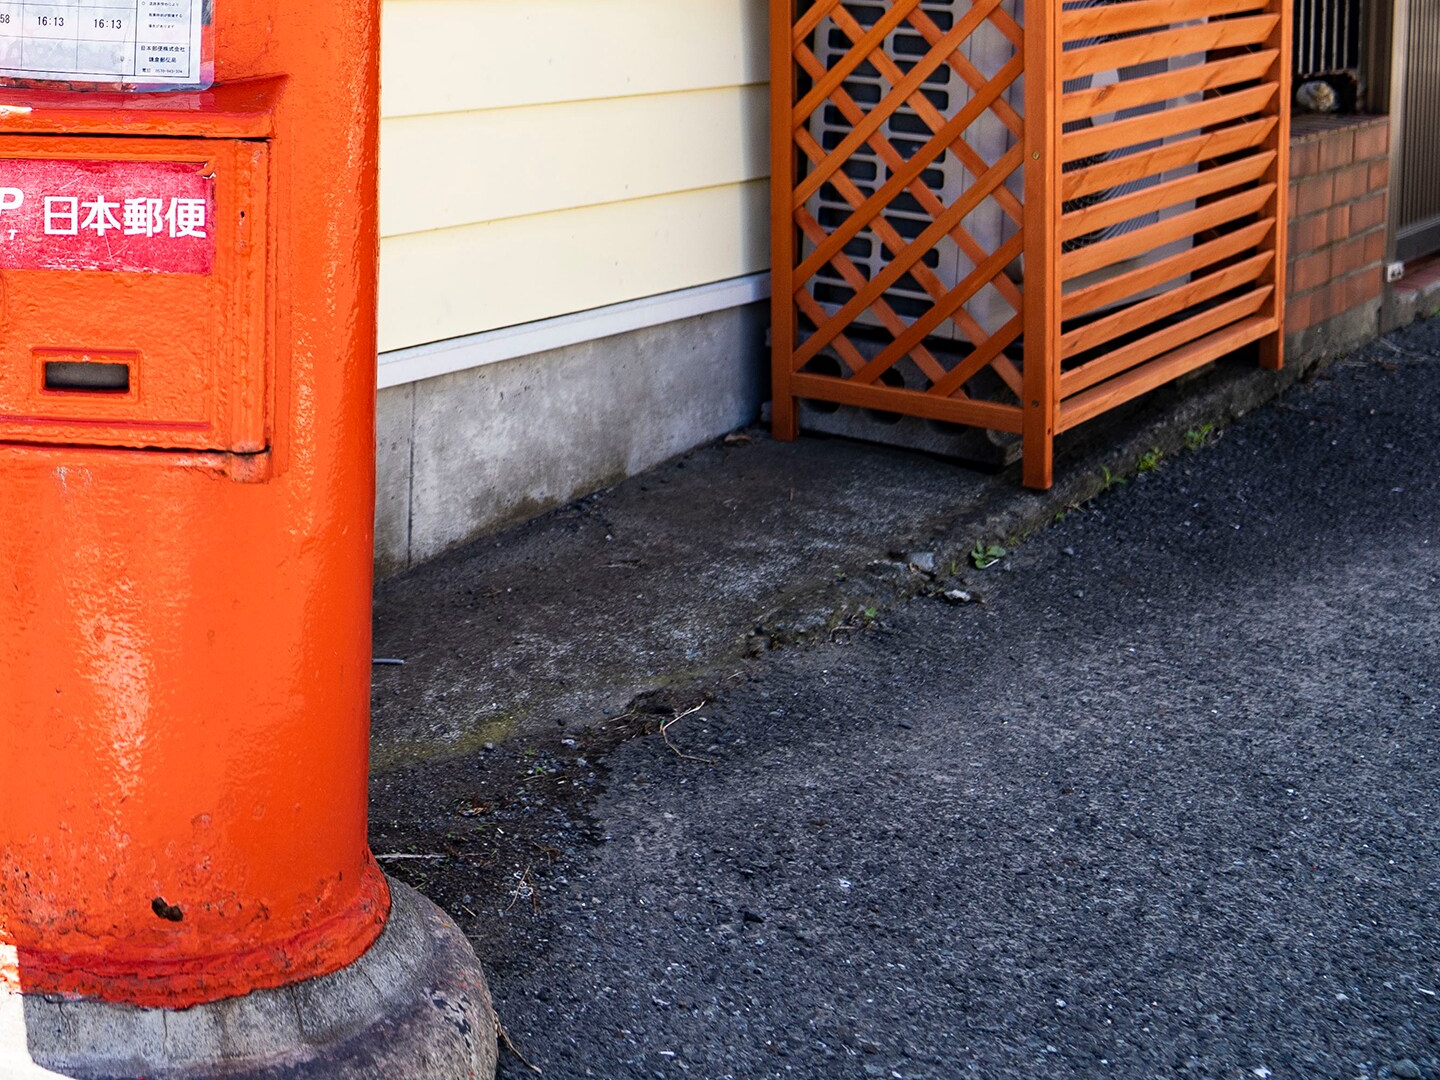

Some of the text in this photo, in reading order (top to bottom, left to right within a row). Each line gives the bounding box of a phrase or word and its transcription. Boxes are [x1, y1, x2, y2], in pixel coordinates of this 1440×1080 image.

[37, 16, 64, 28] 16:13
[93, 18, 122, 30] 16:13
[43, 195, 207, 238] 日本郵便
